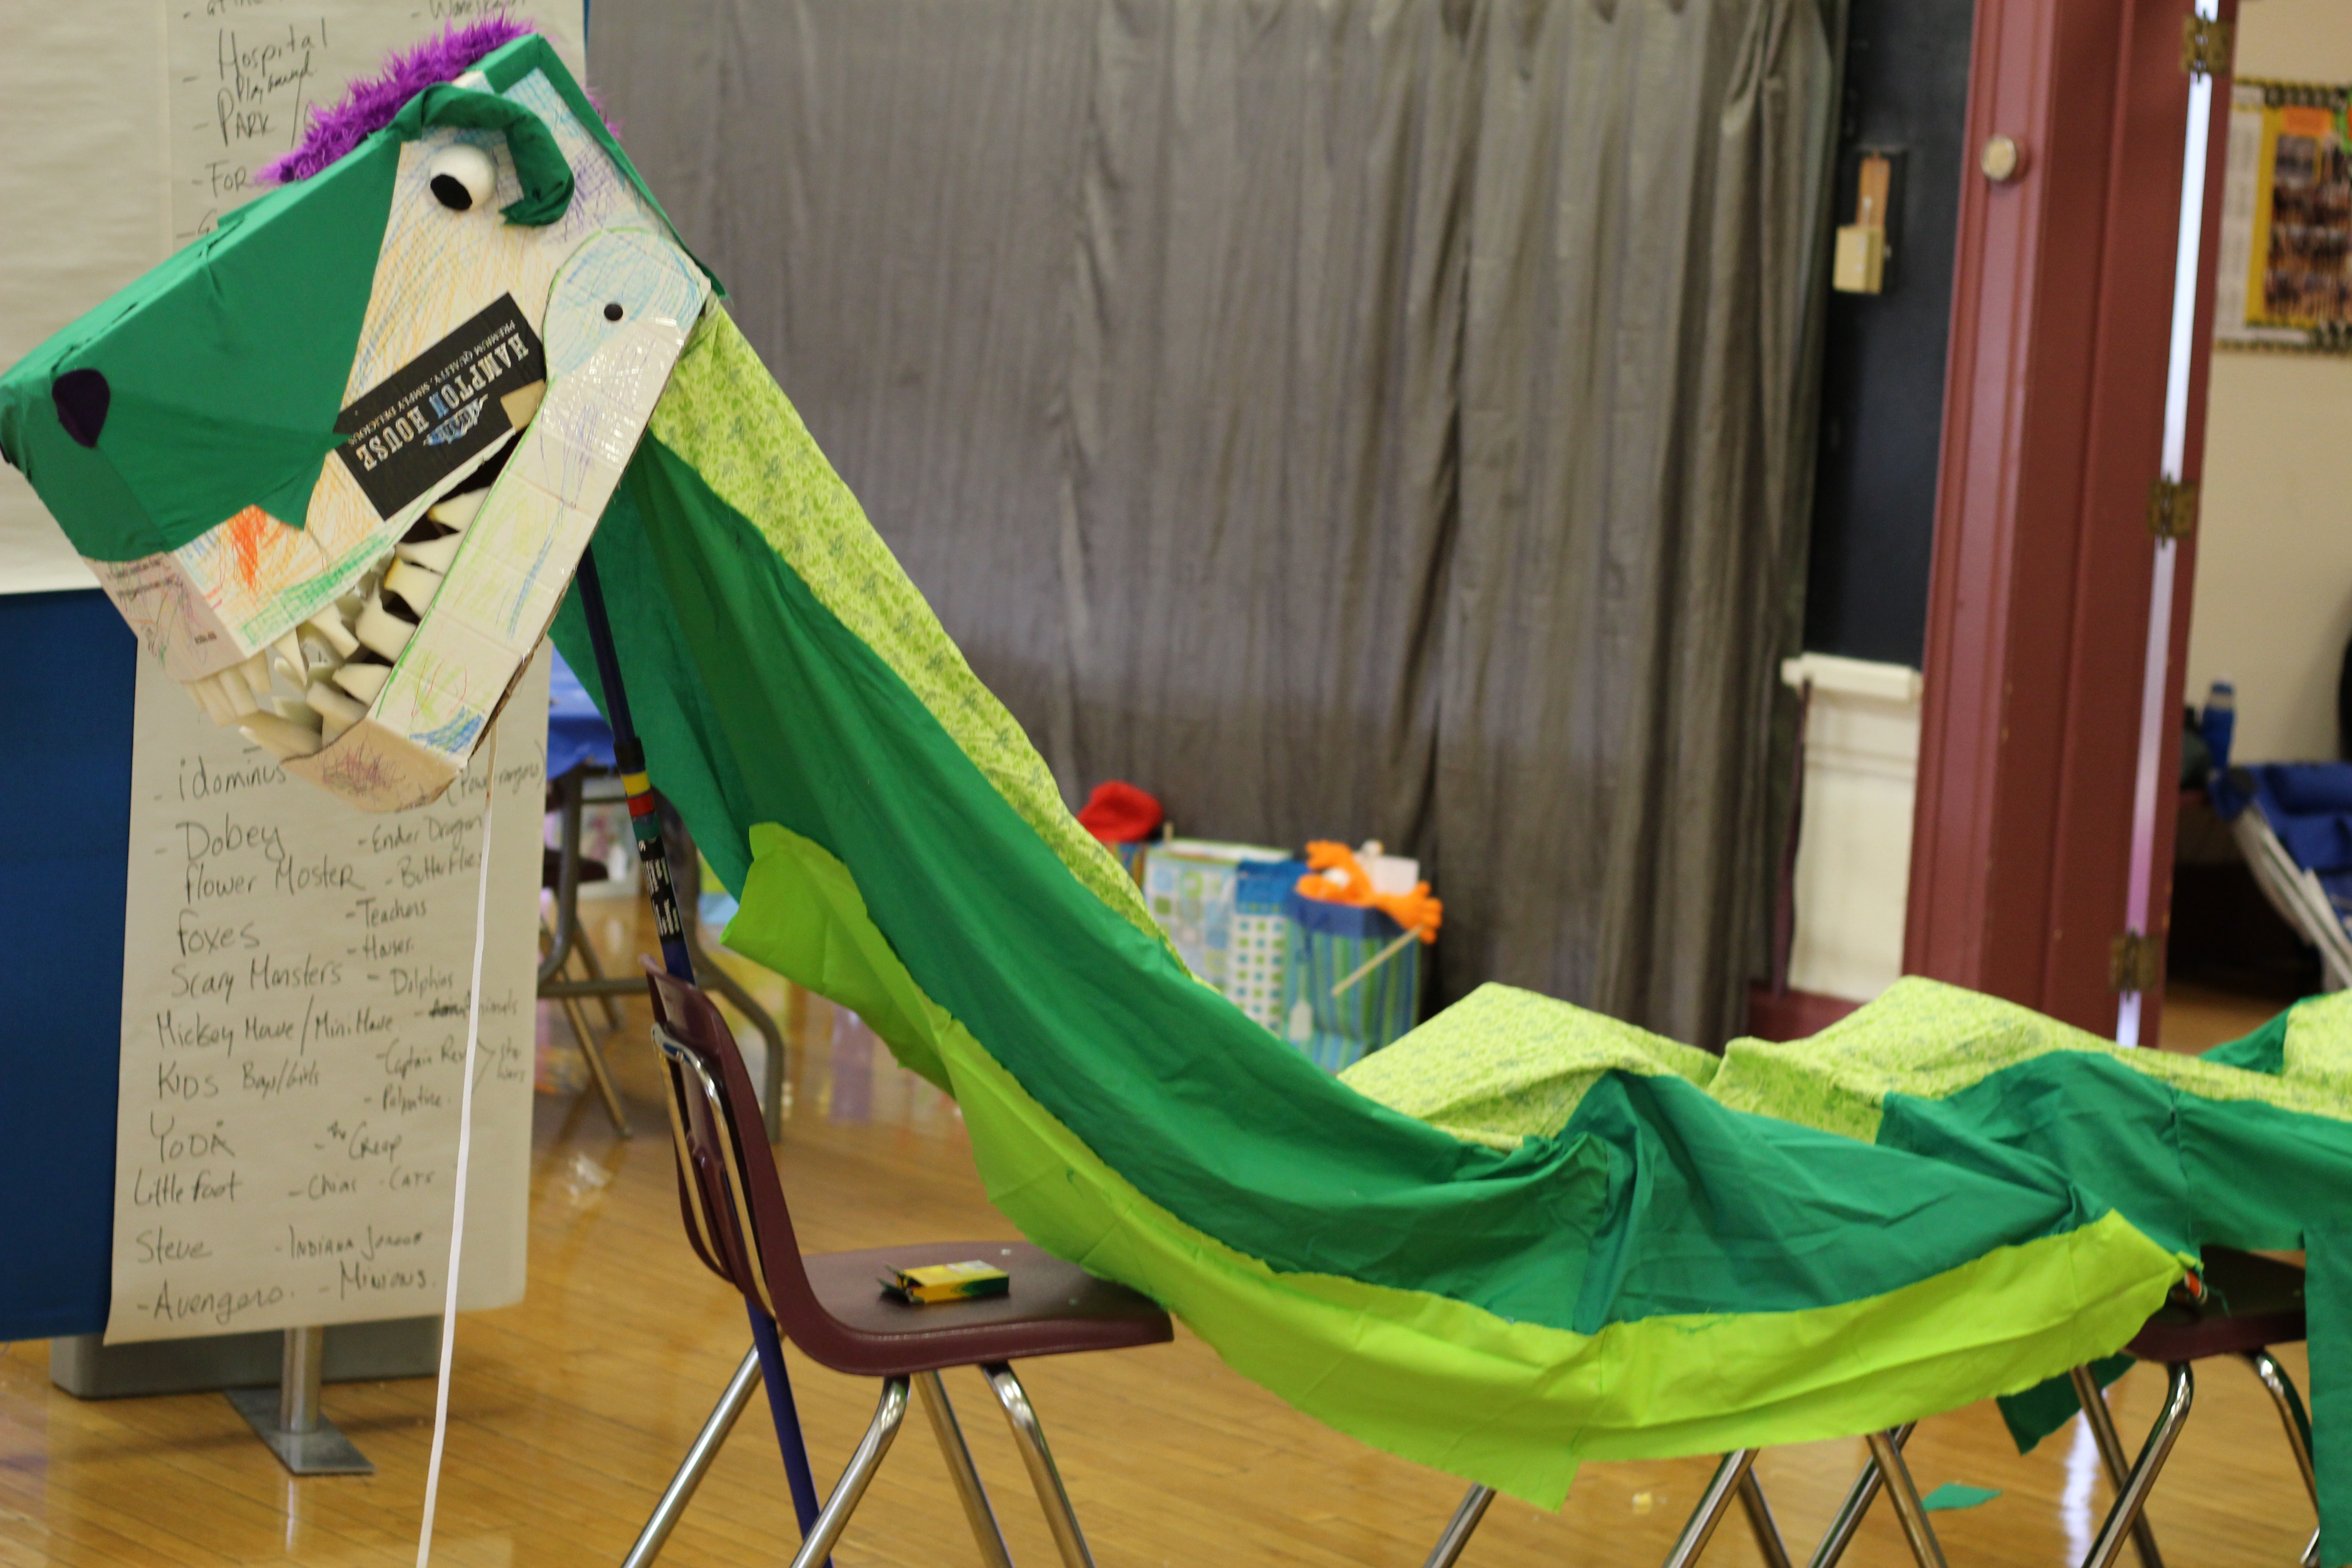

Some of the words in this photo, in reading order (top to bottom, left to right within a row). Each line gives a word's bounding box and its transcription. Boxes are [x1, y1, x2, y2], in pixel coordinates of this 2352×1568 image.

[218, 17, 328, 81] Hospital
[217, 86, 278, 147] PARK
[428, 333, 529, 419] HAMPTON
[356, 405, 430, 471] HOUSE
[175, 813, 286, 862] Dobey
[172, 963, 235, 1004] Scary
[136, 1225, 213, 1265] Steve
